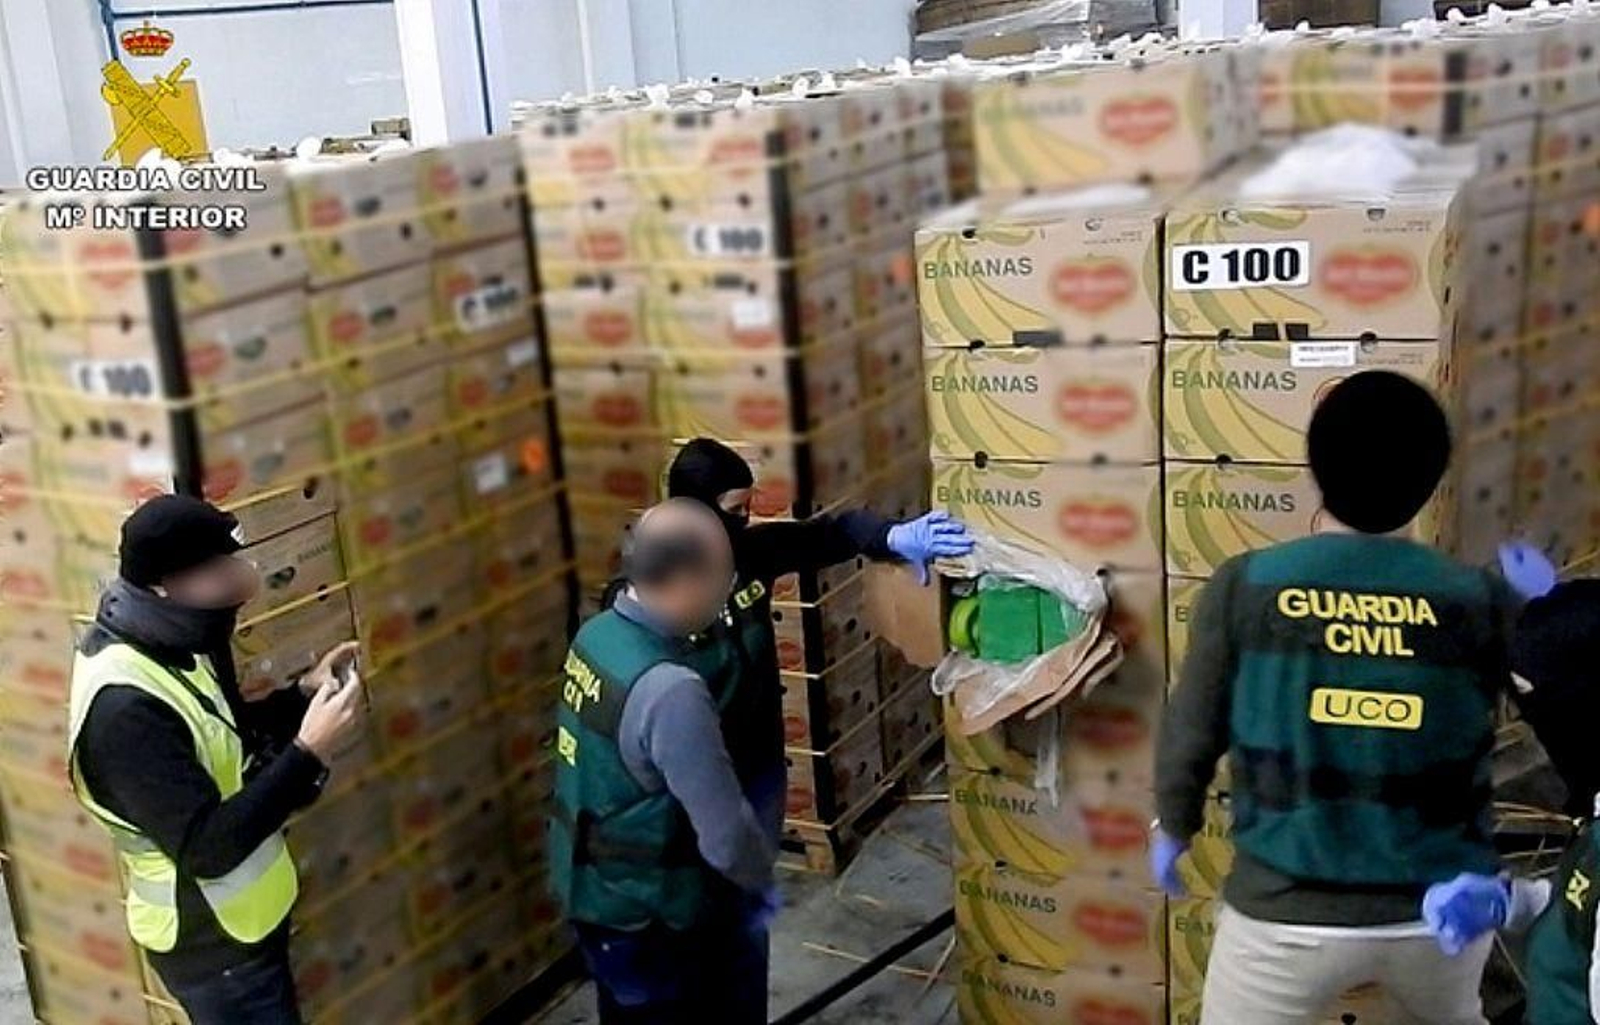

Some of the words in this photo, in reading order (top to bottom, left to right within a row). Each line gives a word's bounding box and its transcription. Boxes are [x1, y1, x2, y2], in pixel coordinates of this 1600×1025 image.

[719, 228, 762, 251] 100
[921, 255, 1034, 280] BANANAS
[1182, 249, 1209, 285] C
[1221, 246, 1300, 284] 100
[101, 364, 151, 396] 100
[930, 373, 1039, 394] BANANAS
[1171, 369, 1297, 392] BANANAS
[935, 484, 1042, 509] BANANAS
[1171, 488, 1296, 513] BANANAS
[1277, 587, 1439, 627] GUARDIA
[1324, 622, 1415, 658] CIVIL
[1324, 693, 1413, 723] UCO
[959, 880, 1058, 913] BANANAS
